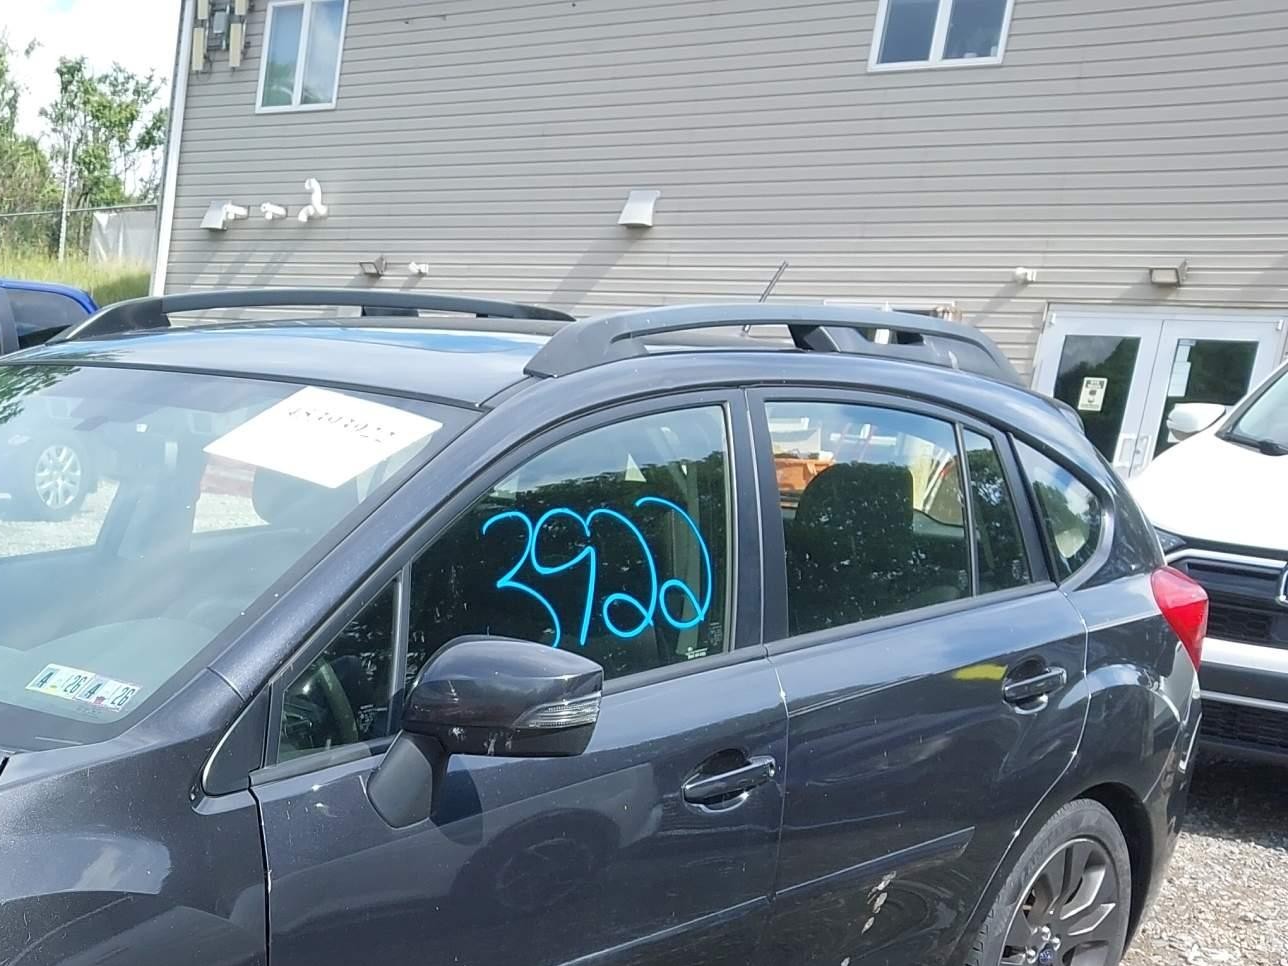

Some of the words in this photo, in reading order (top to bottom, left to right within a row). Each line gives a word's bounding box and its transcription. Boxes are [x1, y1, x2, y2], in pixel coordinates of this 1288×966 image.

[481, 496, 712, 649] 3922
[63, 674, 88, 694] 26
[111, 686, 136, 706] 26
